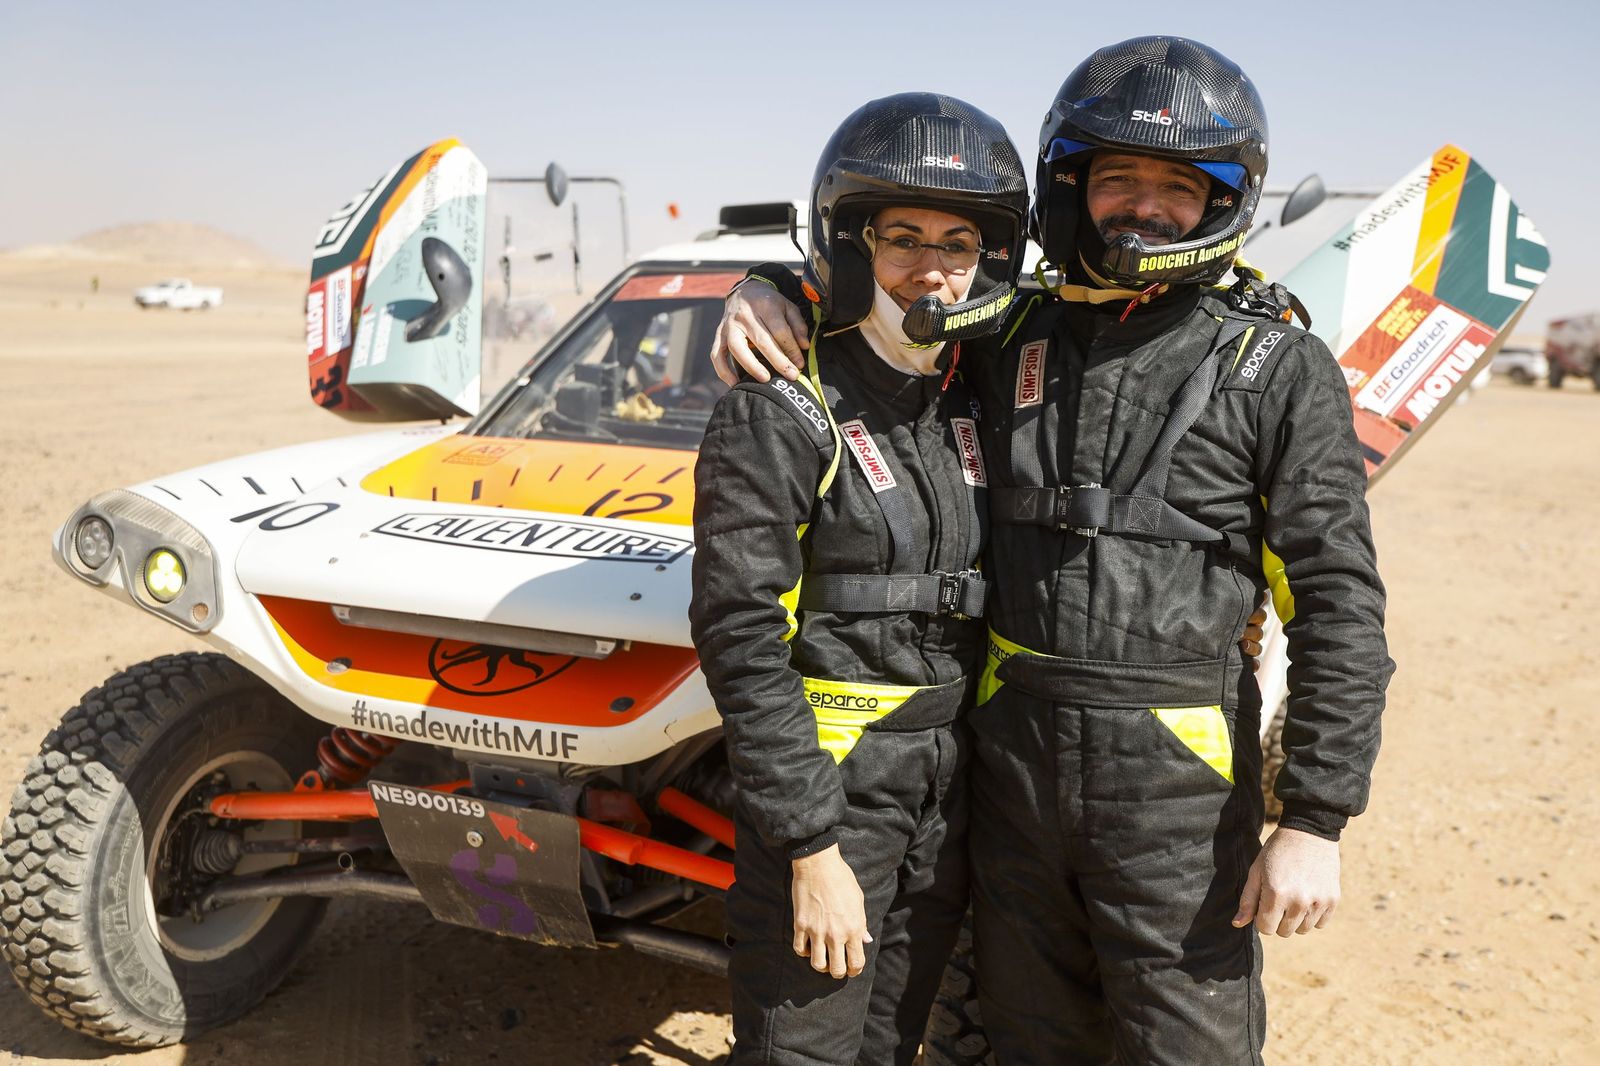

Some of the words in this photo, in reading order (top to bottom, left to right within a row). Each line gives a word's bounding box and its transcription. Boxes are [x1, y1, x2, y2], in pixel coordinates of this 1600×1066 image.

[1131, 108, 1172, 126] Stilo
[925, 155, 965, 171] Stilo
[1332, 153, 1462, 252] #madewithMJF
[1139, 250, 1197, 272] BOUCHET
[1197, 238, 1238, 263] Aurélien
[307, 290, 325, 355] MOTUL
[944, 301, 995, 332] HUGUENIN
[1022, 348, 1039, 401] SIMPSON
[1241, 331, 1283, 379] sparco
[1373, 319, 1449, 399] BFGoodrich
[772, 379, 829, 432] sparco
[1405, 339, 1485, 423] MOTUL
[848, 427, 888, 483] SIMPSON
[959, 426, 982, 481] SIMPSON
[229, 499, 341, 531] 10
[583, 489, 674, 518] 12
[809, 691, 879, 709] sparco
[351, 699, 578, 759] #madewithMJF
[372, 783, 486, 819] NE900139
